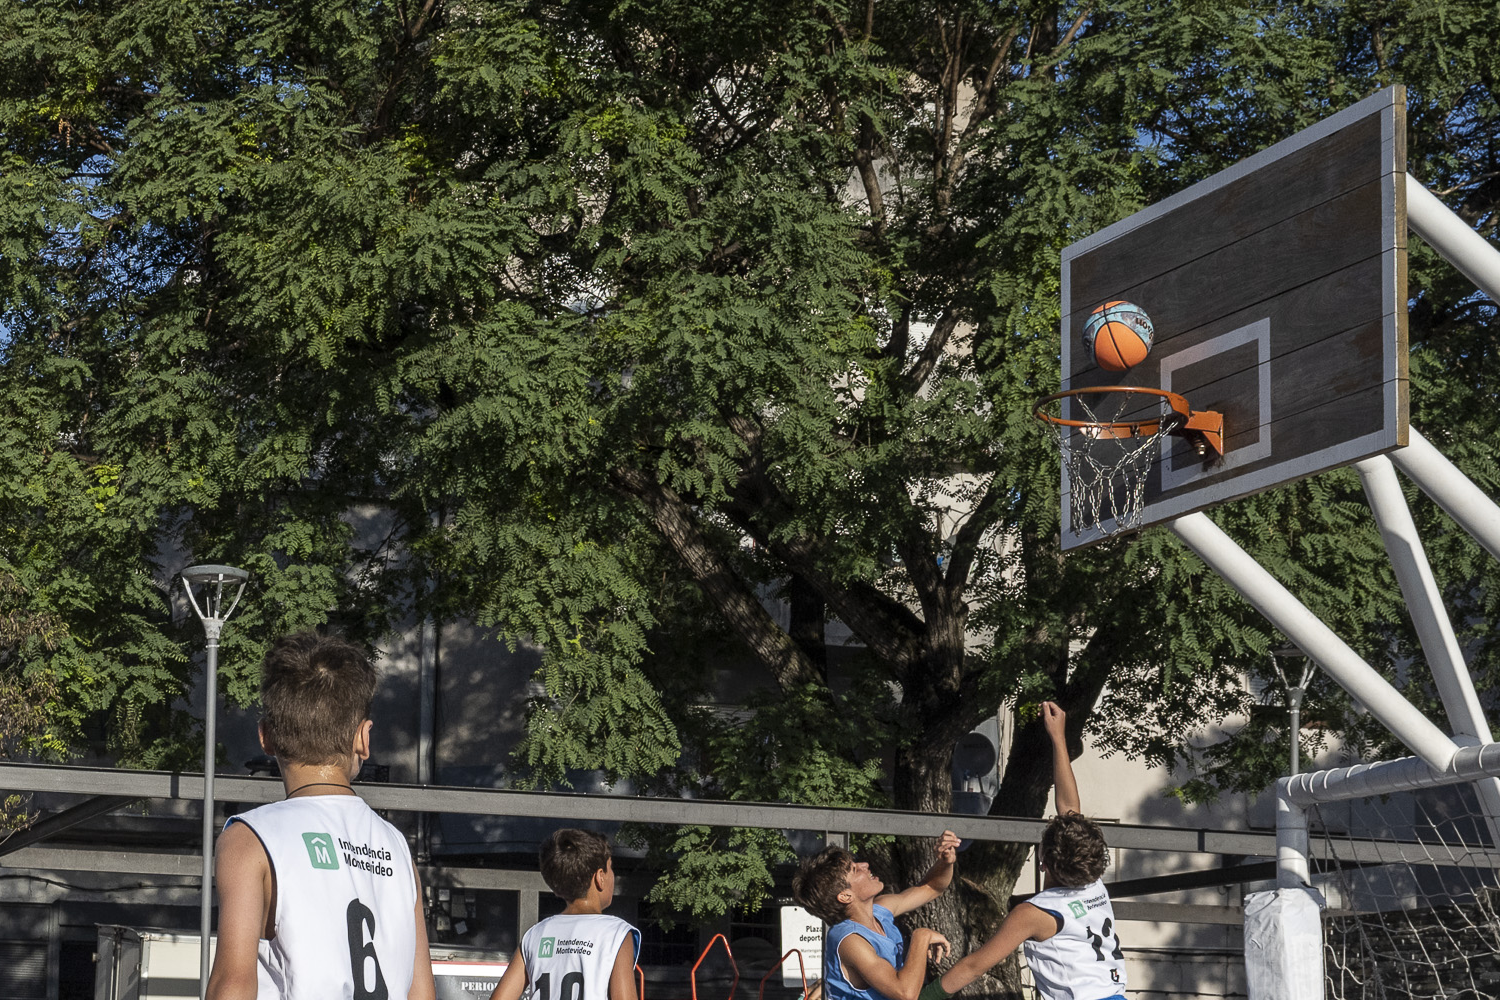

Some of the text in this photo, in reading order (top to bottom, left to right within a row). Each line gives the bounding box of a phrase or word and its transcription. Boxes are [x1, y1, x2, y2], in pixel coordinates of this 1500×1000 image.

[338, 837, 392, 861] Intendencia
[557, 938, 594, 949] Intendencia
[556, 946, 592, 956] Montevideo
